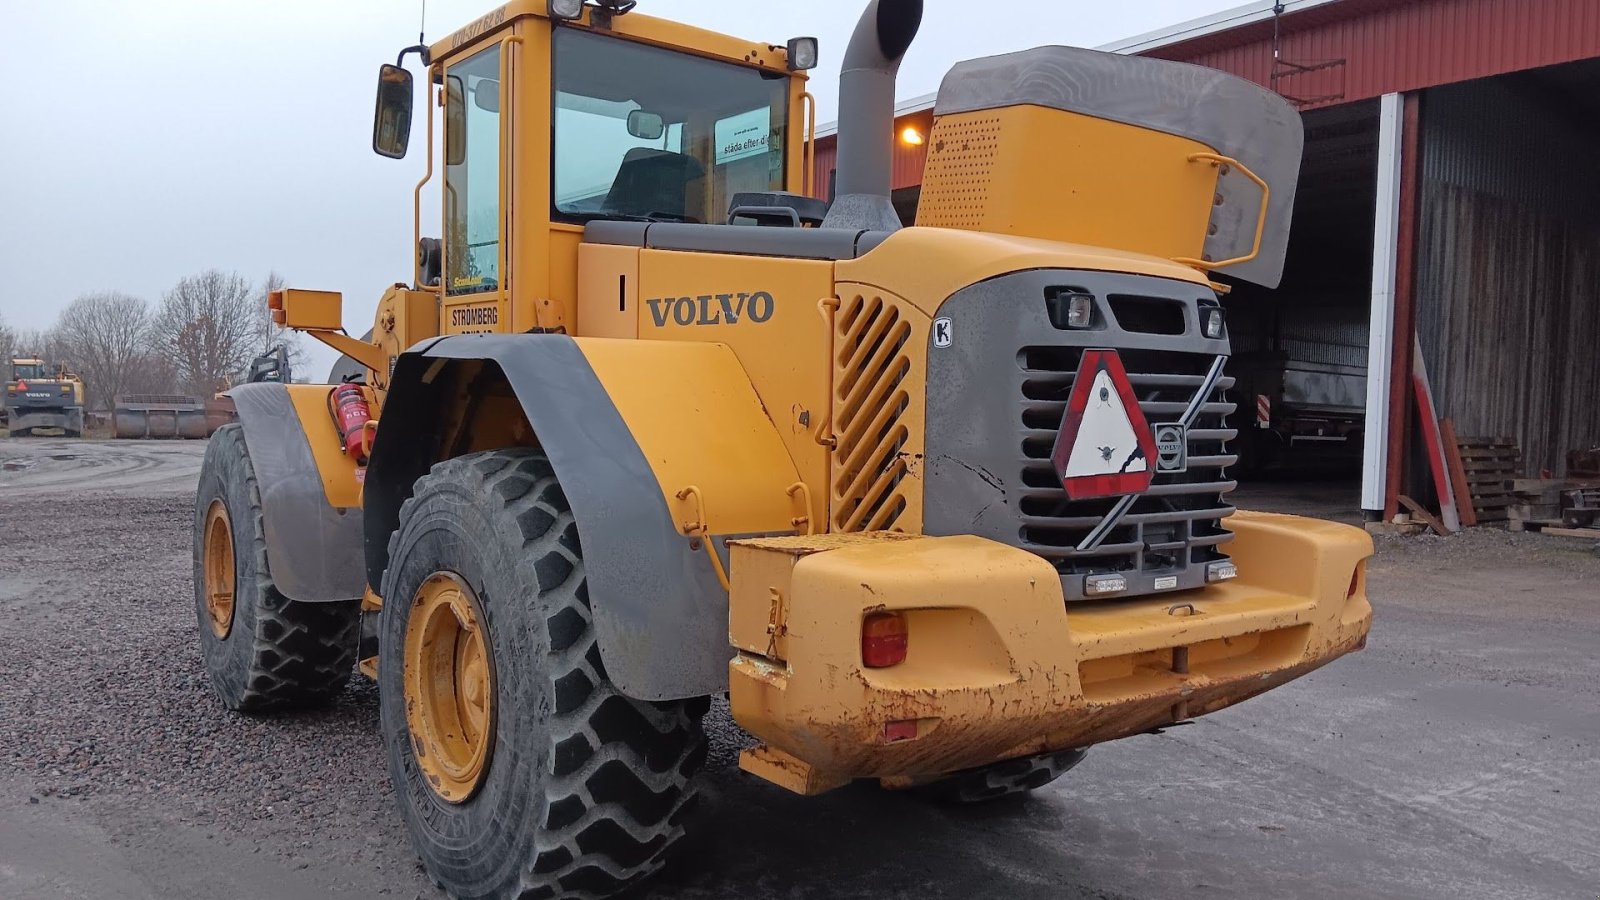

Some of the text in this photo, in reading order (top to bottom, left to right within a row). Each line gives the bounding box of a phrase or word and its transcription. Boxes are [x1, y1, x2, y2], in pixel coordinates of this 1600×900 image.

[743, 138, 759, 149] efter
[452, 304, 498, 326] STRÖMBERG
[646, 291, 774, 327] VOLVO
[937, 322, 949, 342] K
